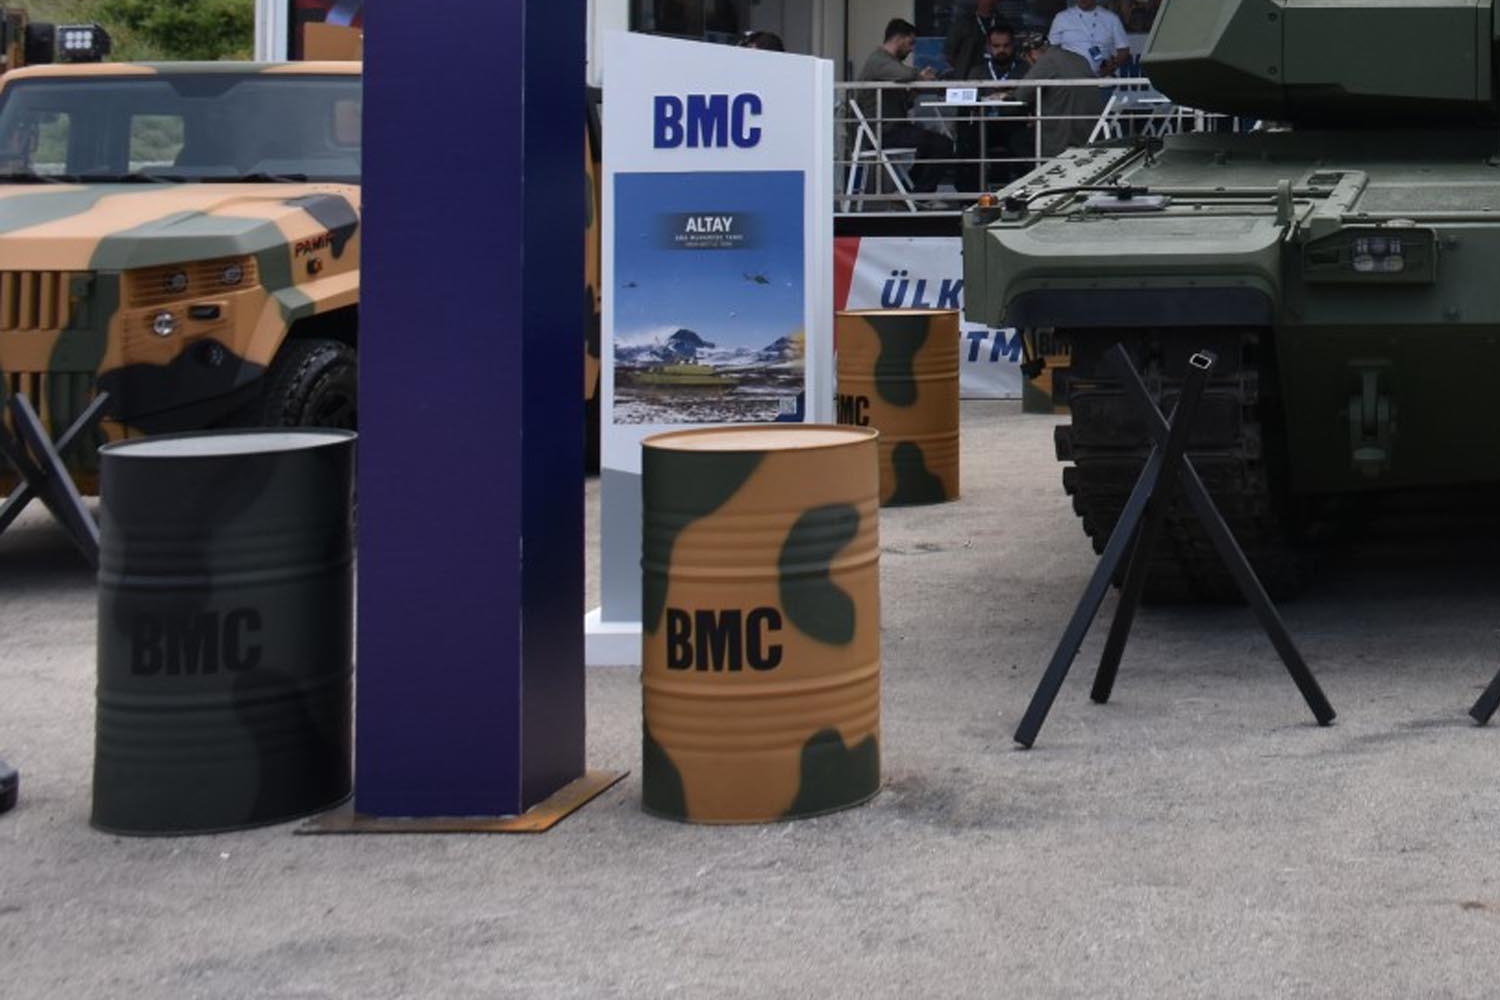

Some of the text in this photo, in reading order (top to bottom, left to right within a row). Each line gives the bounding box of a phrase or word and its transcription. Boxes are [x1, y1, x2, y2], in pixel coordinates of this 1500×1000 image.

[653, 93, 762, 149] BMC
[685, 216, 733, 233] ALTAY
[881, 269, 966, 312] ÜLK
[958, 331, 1022, 362] TM
[837, 394, 870, 428] MC
[130, 607, 263, 676] BMC
[666, 606, 783, 672] BMC
